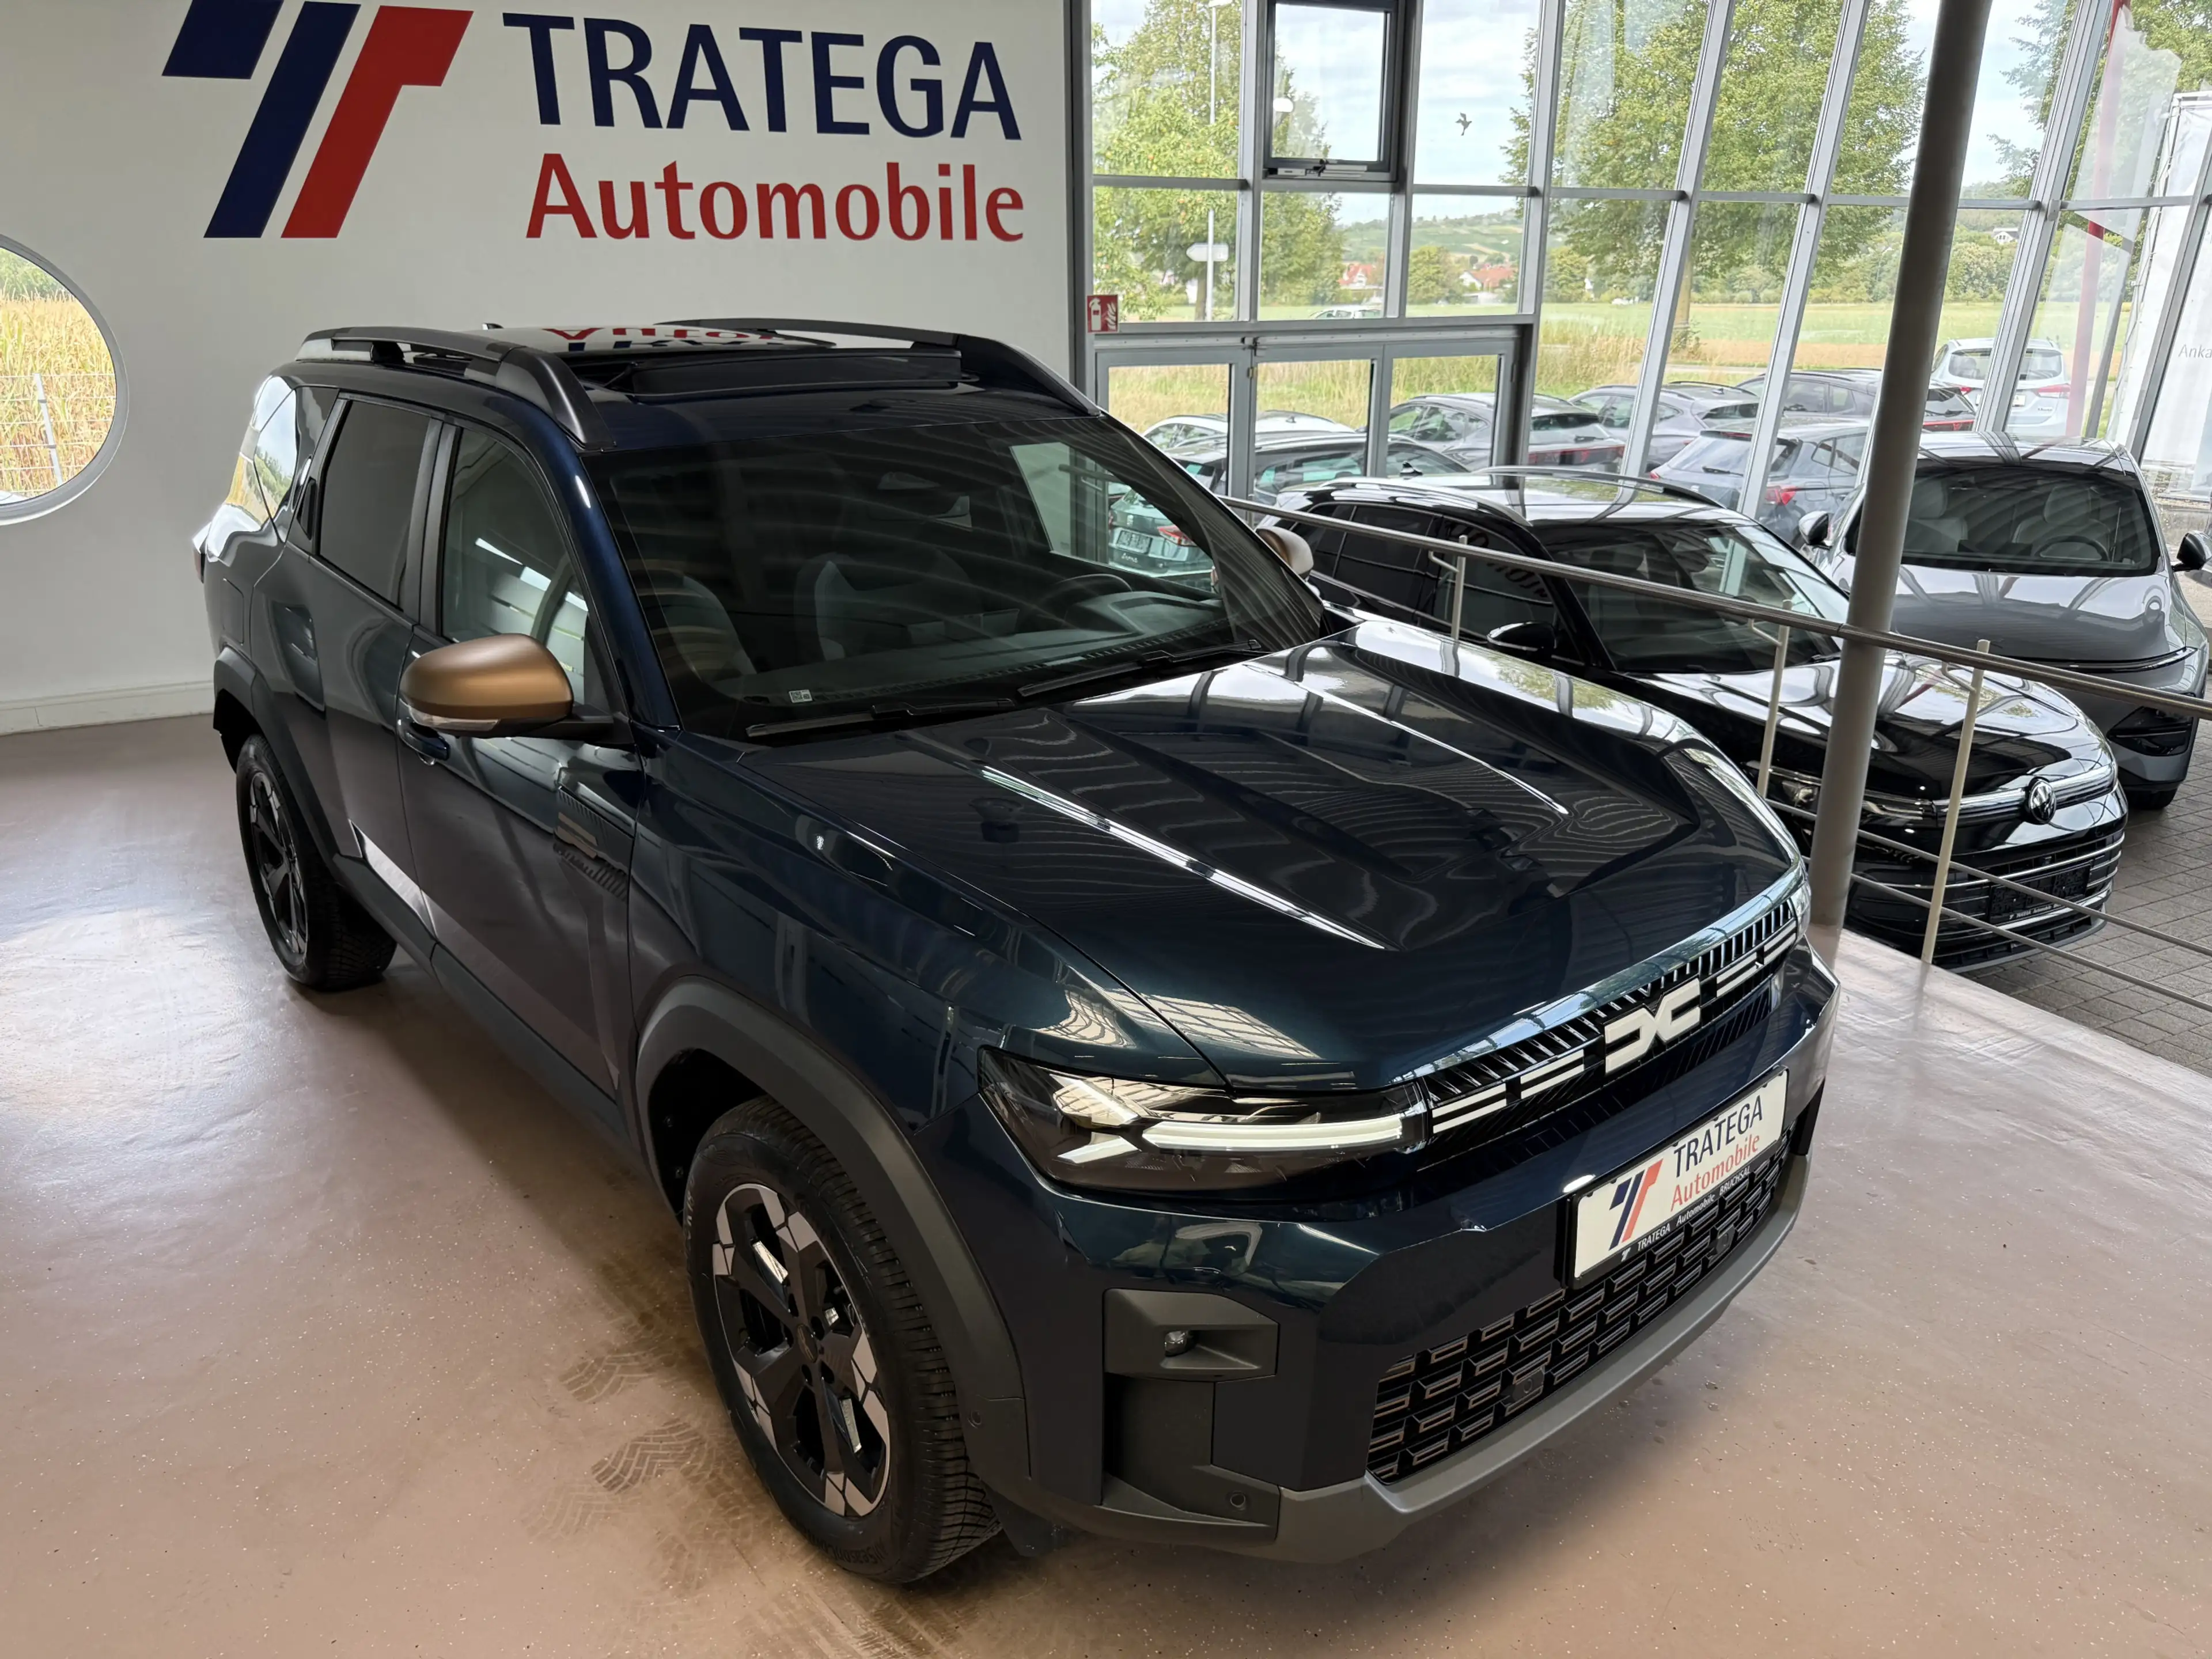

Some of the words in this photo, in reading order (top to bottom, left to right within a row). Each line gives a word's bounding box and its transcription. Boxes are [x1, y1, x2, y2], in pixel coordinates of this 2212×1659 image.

[502, 12, 1021, 141] TRATEGA
[526, 153, 1024, 242] Automobile
[1671, 1134, 1760, 1212] Automobile
[1673, 1095, 1762, 1178] TRATEGA
[1637, 1223, 1671, 1252] TRATEGA
[1676, 1194, 1715, 1227] Automobile
[1719, 1166, 1751, 1196] BRUCHSAL
